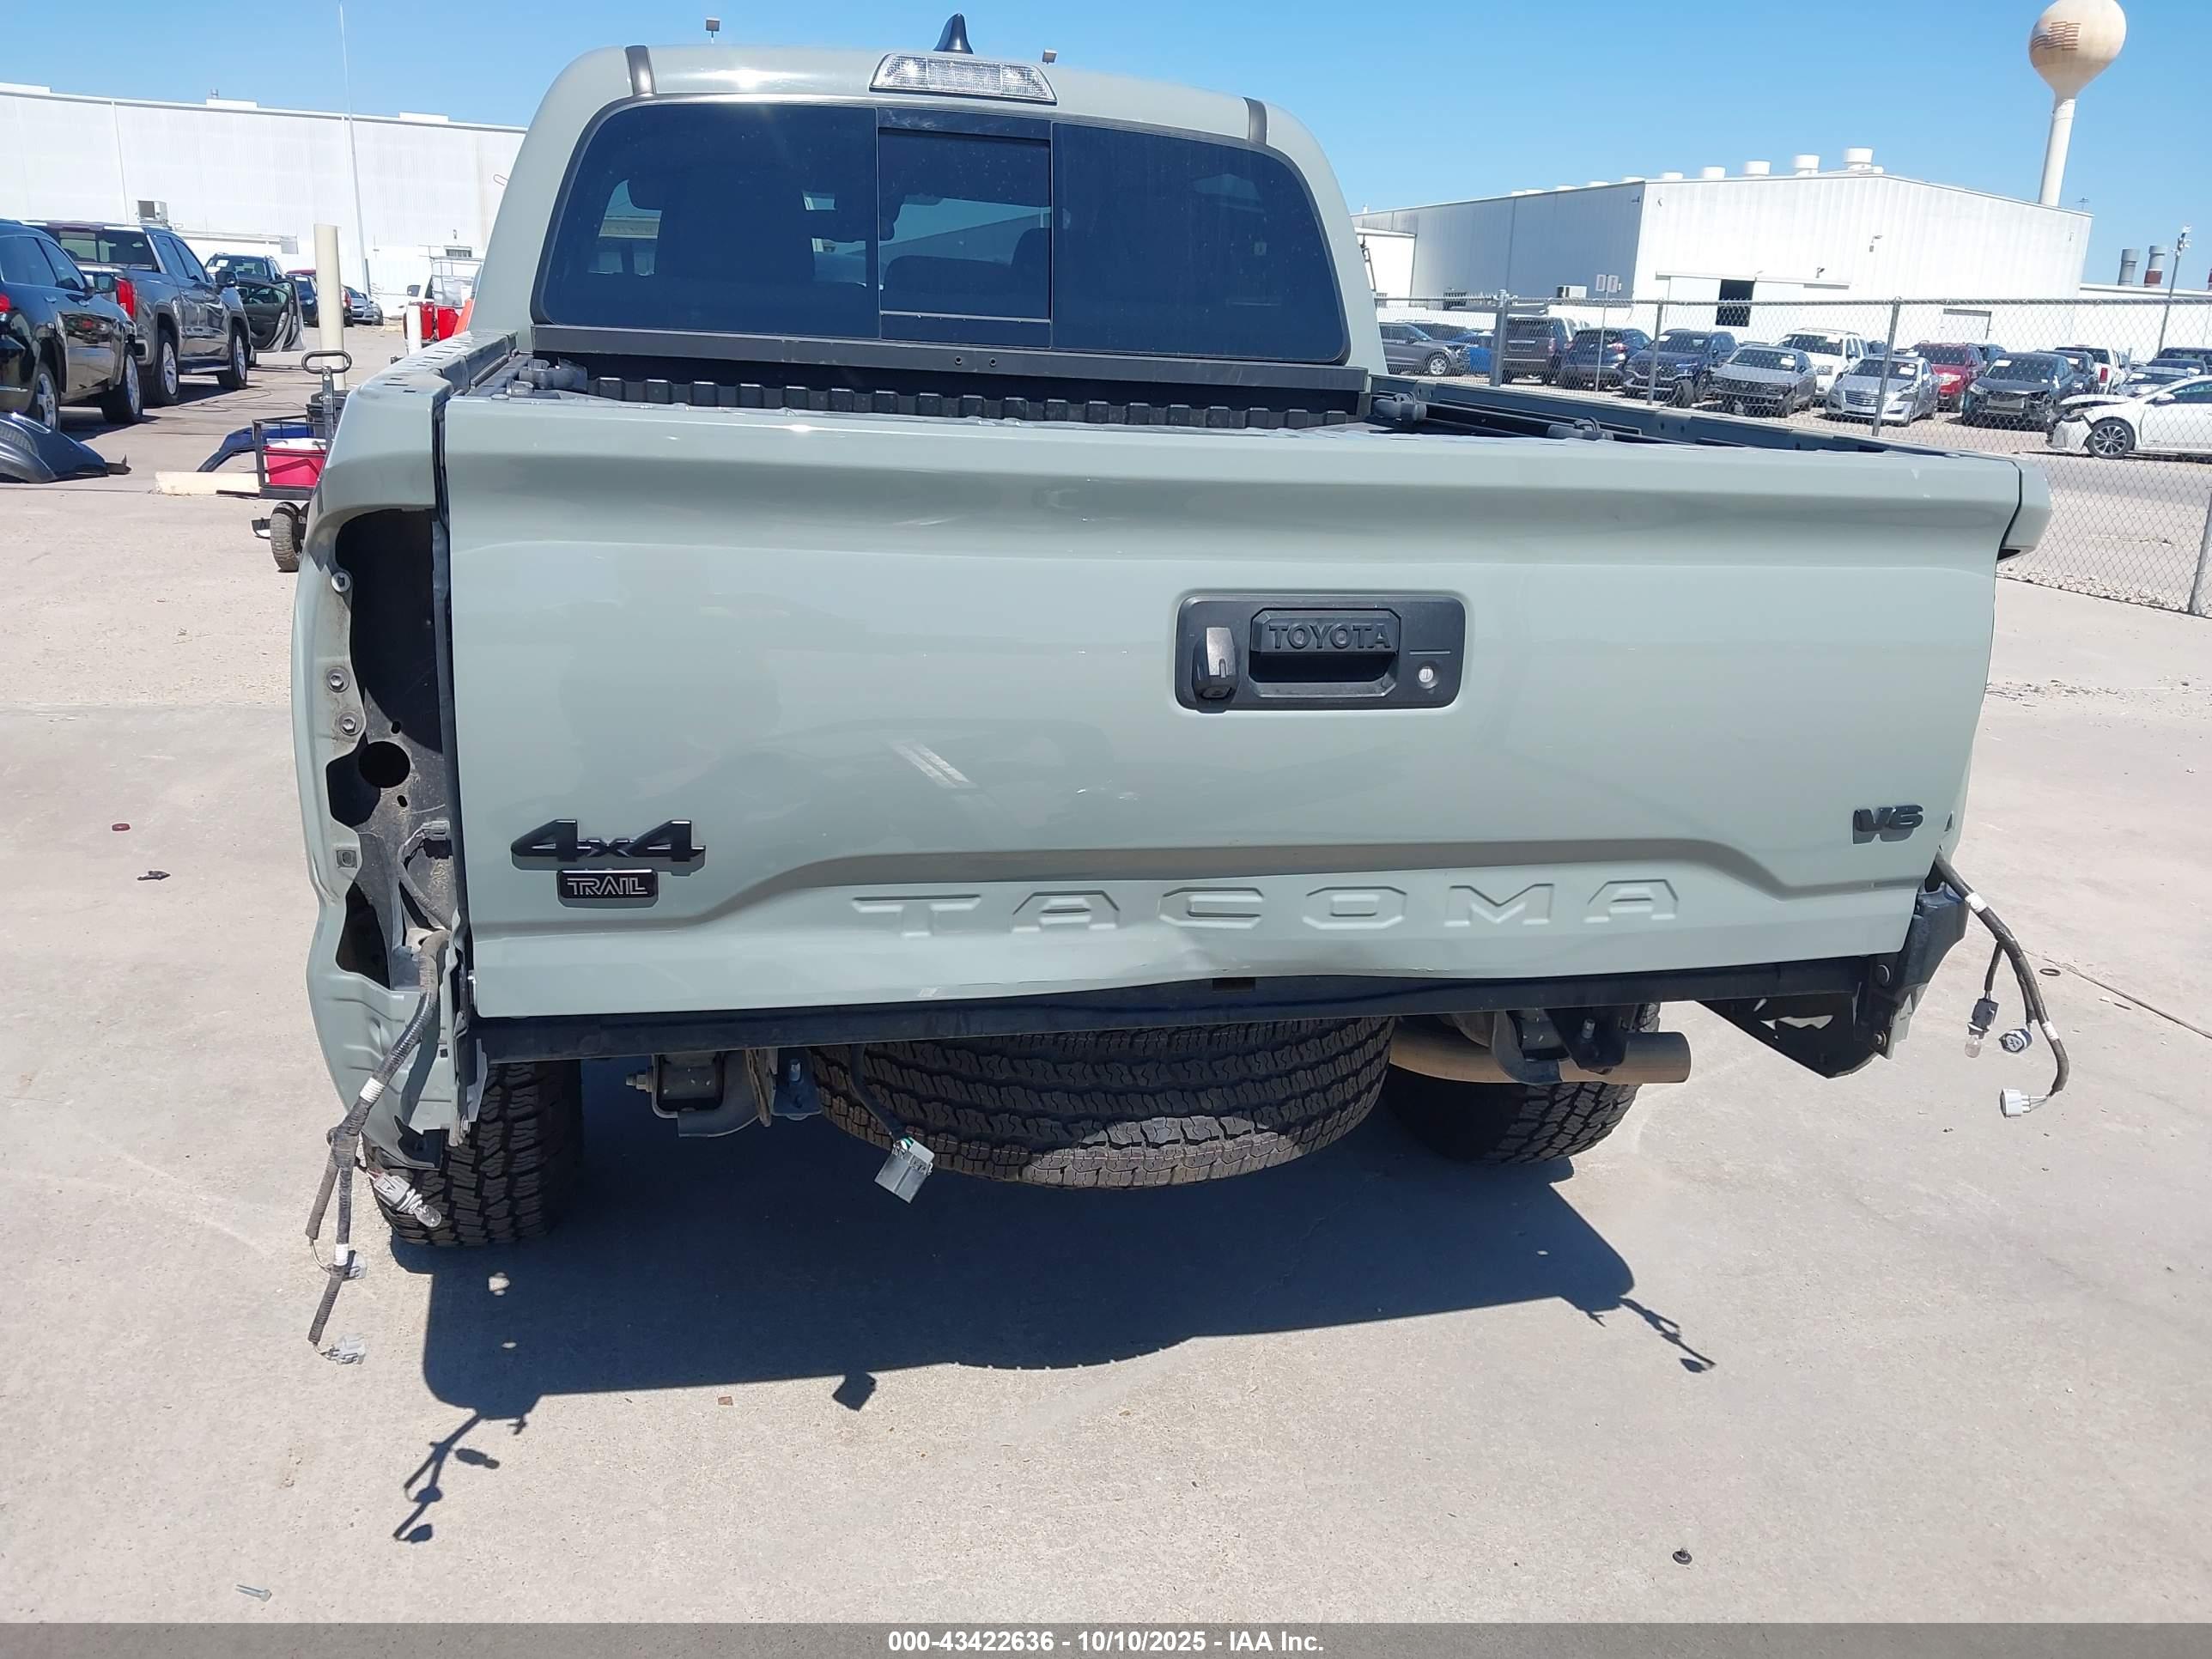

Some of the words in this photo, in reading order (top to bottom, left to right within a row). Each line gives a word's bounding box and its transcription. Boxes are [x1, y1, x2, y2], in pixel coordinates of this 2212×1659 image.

[1269, 623, 1391, 649] TOYOTA
[1853, 805, 1923, 833] V6
[567, 876, 647, 896] TRAIL
[852, 879, 1678, 936] TACOMA
